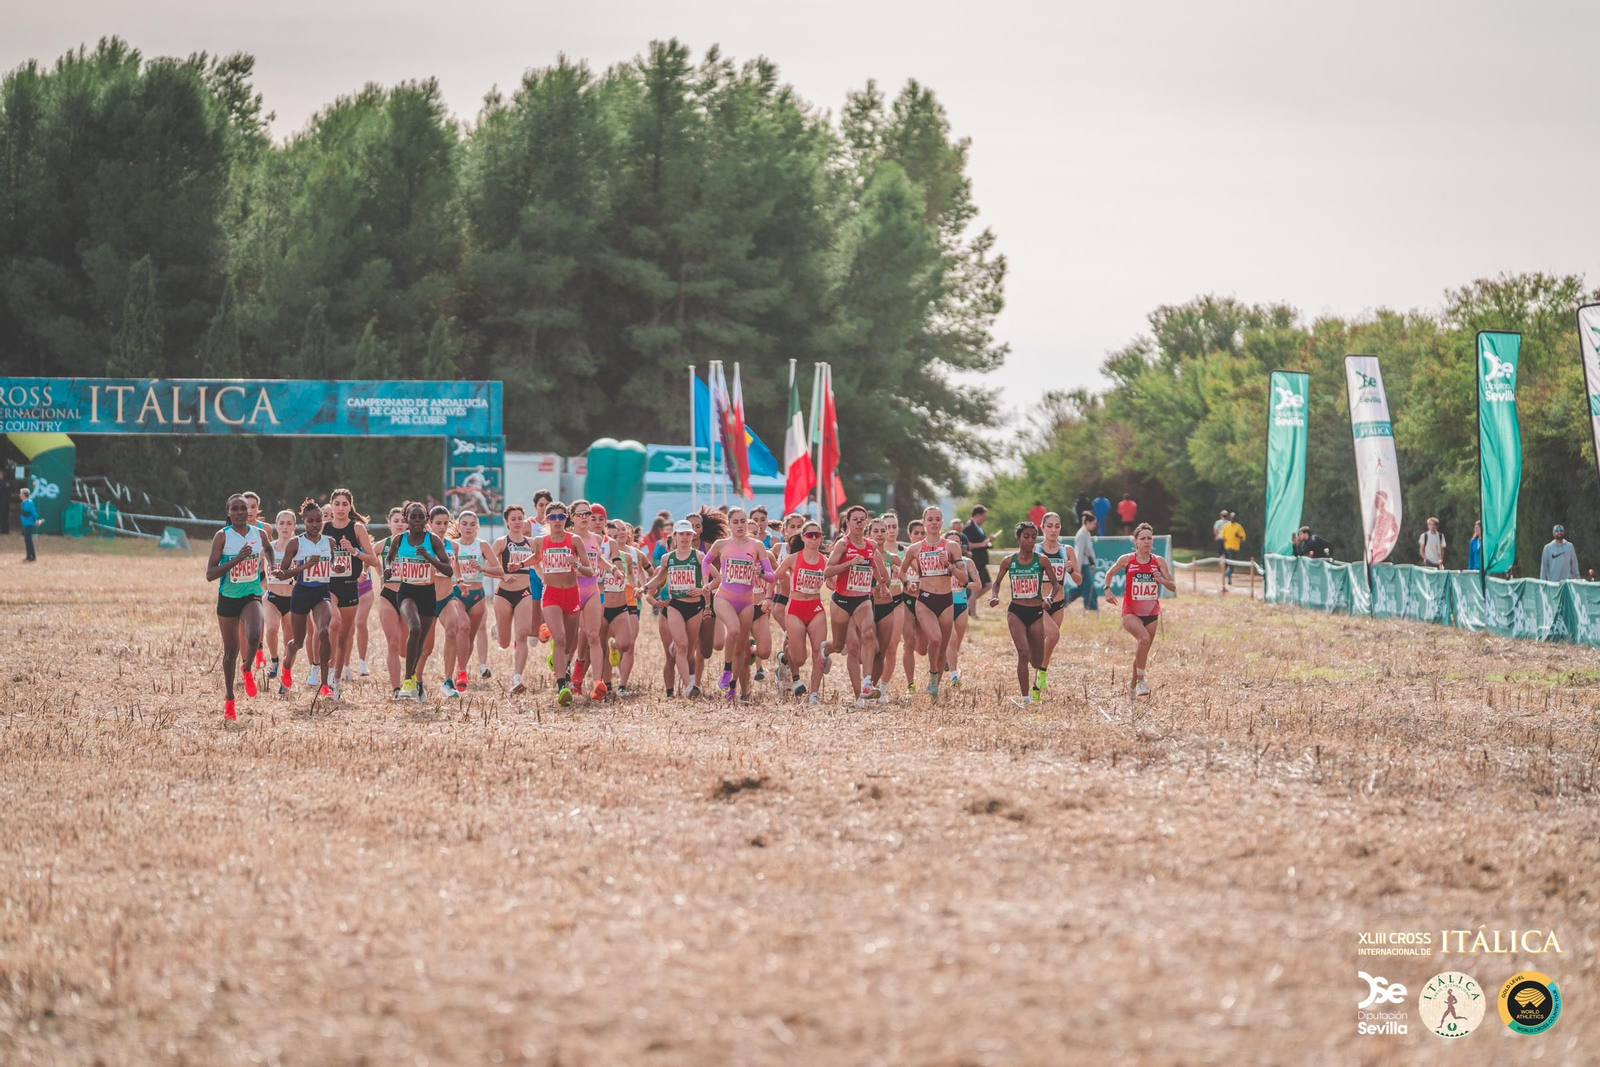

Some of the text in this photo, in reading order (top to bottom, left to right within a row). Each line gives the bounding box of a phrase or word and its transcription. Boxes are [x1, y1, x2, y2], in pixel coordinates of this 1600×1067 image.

[89, 378, 281, 424] ITÁLICA
[347, 397, 489, 407] CAMPEONATO DE ANDALUCÍA
[369, 407, 382, 415] DE
[383, 407, 419, 415] CAMPO
[420, 407, 429, 415] A
[5, 421, 62, 431] COUNTRY
[391, 415, 447, 425] POR CLUBES
[402, 562, 430, 578] BIWOT
[726, 564, 752, 580] FORERO
[670, 570, 695, 585] CORRAL
[1132, 582, 1157, 596] DÍAZ
